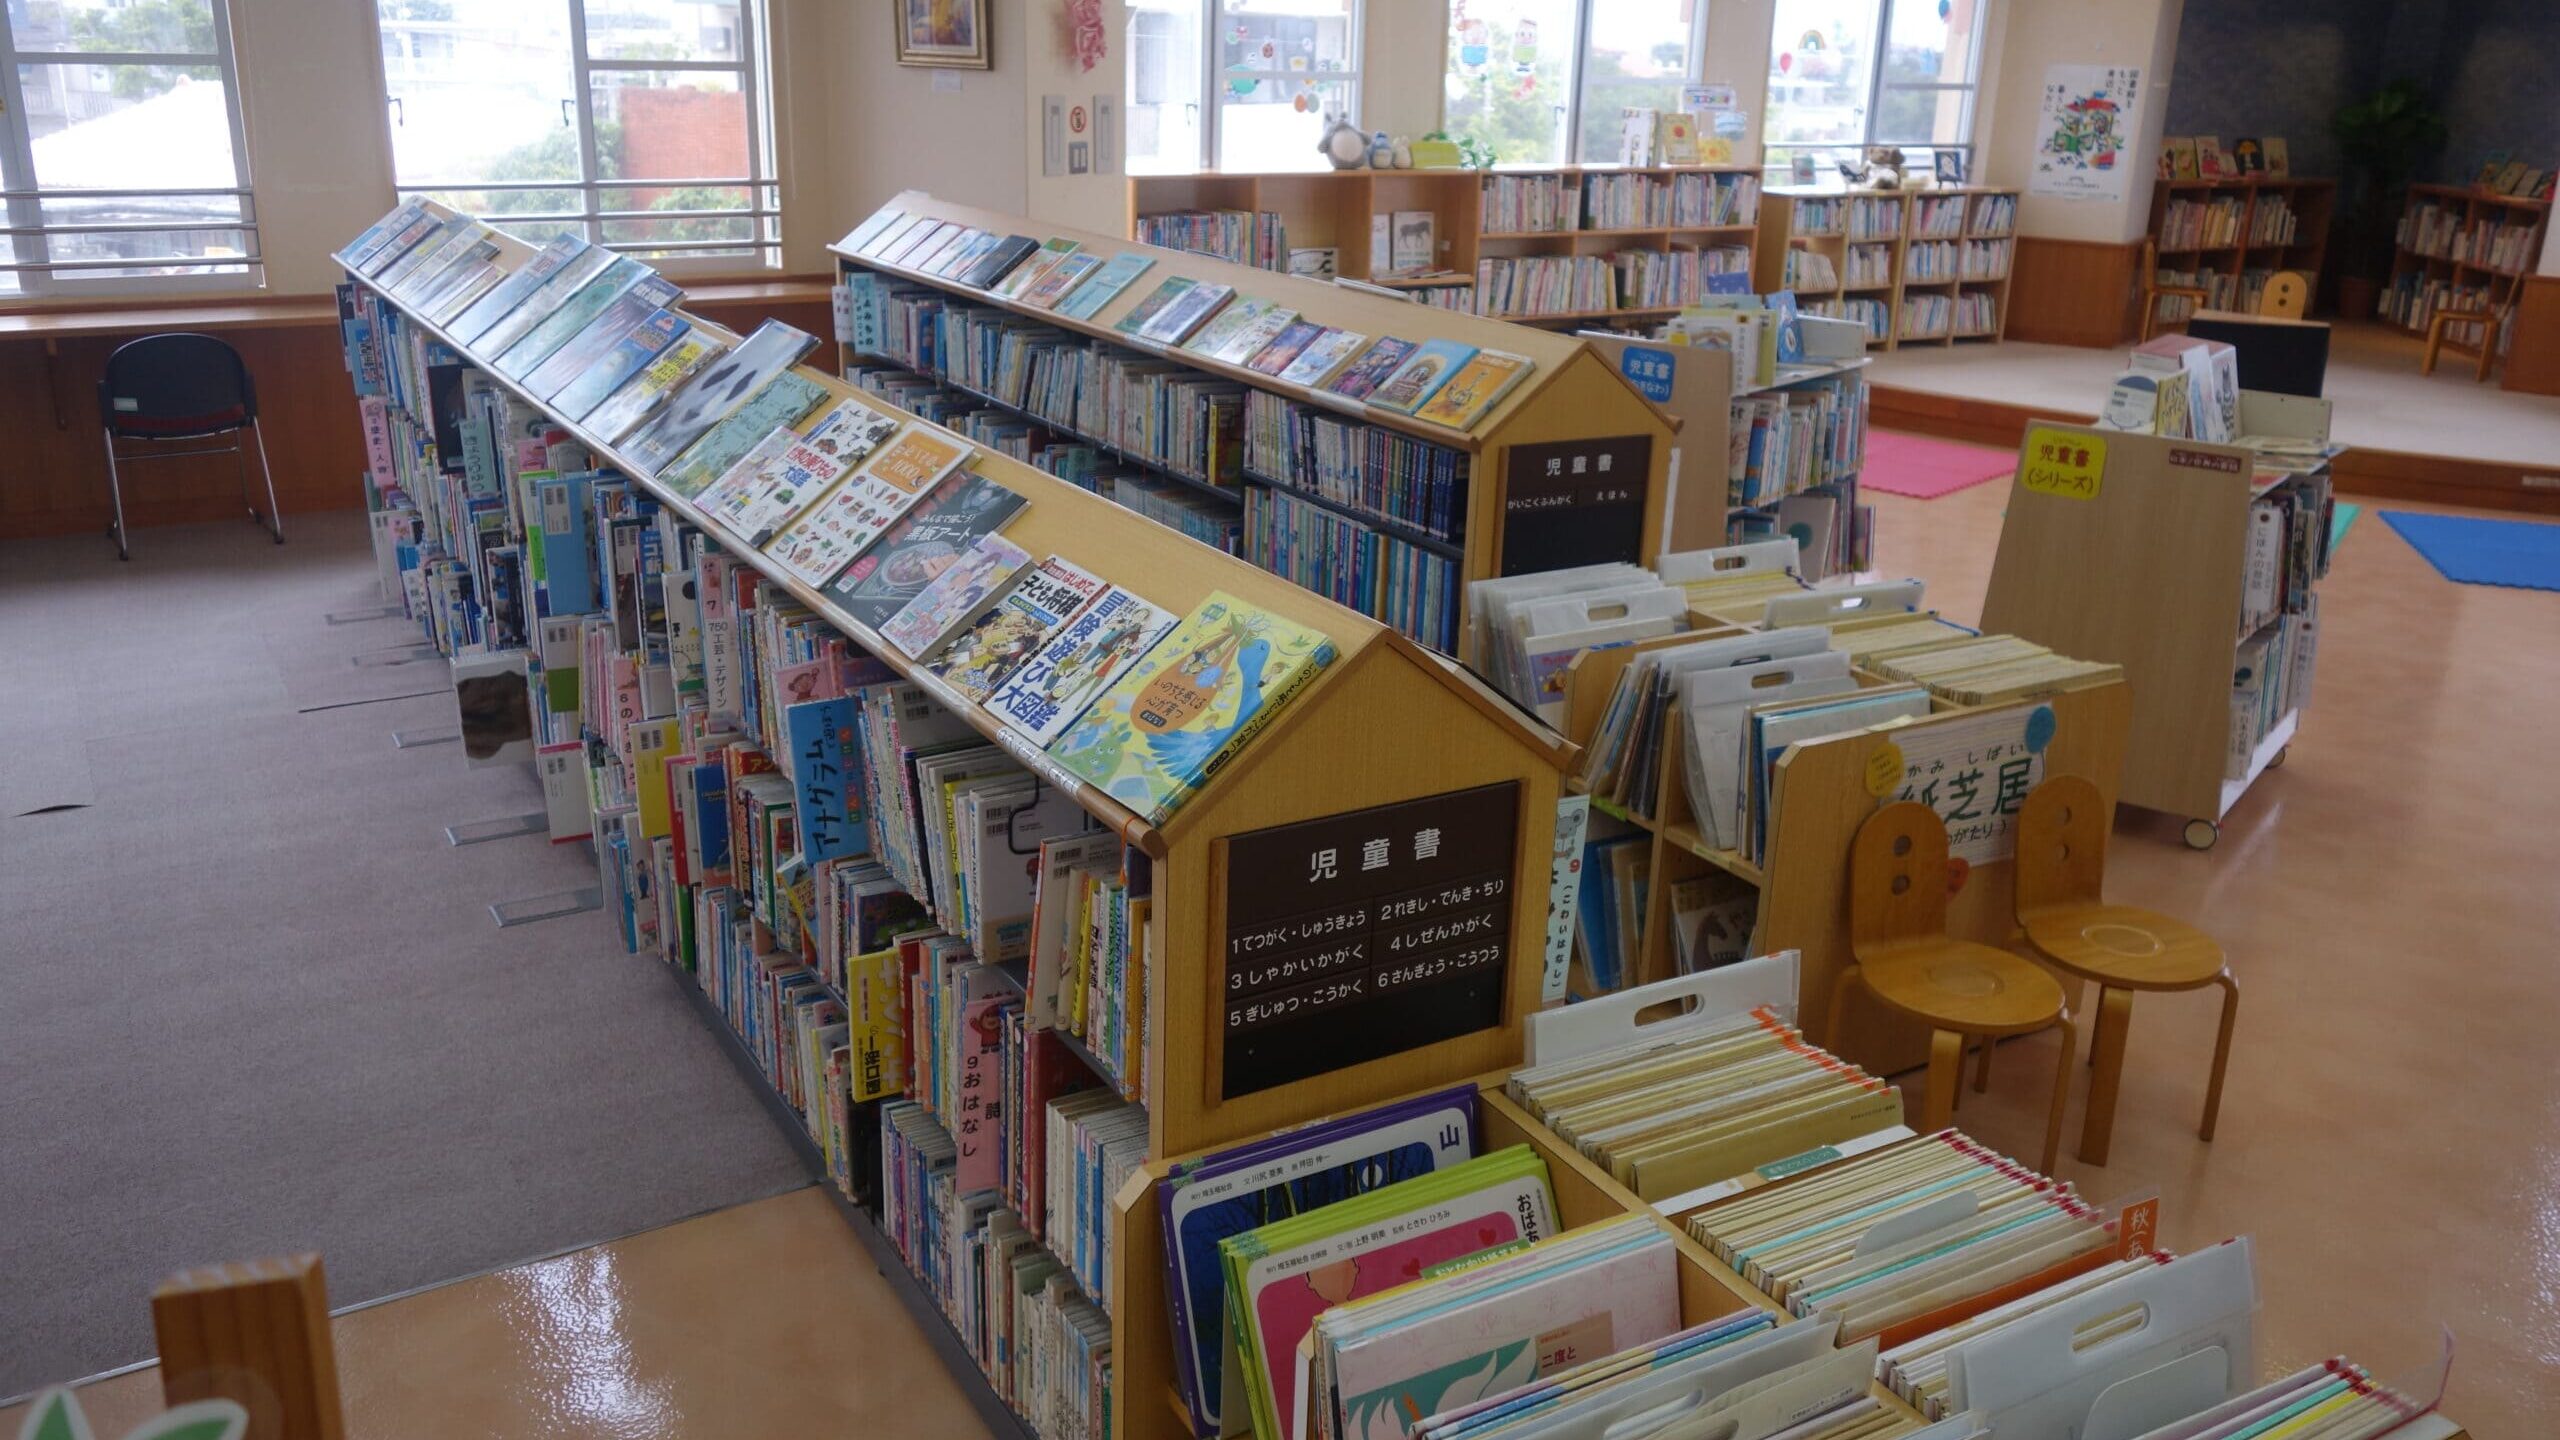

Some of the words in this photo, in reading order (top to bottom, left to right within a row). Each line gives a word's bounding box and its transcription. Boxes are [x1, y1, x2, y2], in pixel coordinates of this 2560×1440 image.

[1629, 359, 1670, 380] 児童書
[1546, 453, 1613, 477] 児童書
[2039, 444, 2090, 468] 児童書
[2028, 467, 2094, 493] (シリーズ)
[708, 621, 729, 631] 750
[1022, 589, 1129, 684] 冒険遊び
[712, 633, 729, 707] 工芸・デザイン
[994, 685, 1061, 732] 大図鑑
[1144, 696, 1184, 720] 心が育つ
[1908, 760, 1945, 778] かみ
[1968, 744, 2025, 764] しばい
[806, 737, 841, 856] アナグラム
[1308, 827, 1441, 883] 児童書
[1569, 858, 1581, 874] 9
[1380, 878, 1505, 921] 2れきし・でんき・ちり
[1231, 910, 1367, 955] 1てつがく・しゅうきょう
[1390, 913, 1493, 951] 4しぜんかがく
[1230, 944, 1364, 990] 3しゃかいかがく
[1377, 944, 1500, 989] 6さんぎょう・こうつう
[1439, 1124, 1462, 1151] 山
[1541, 1345, 1577, 1369] 二度と
